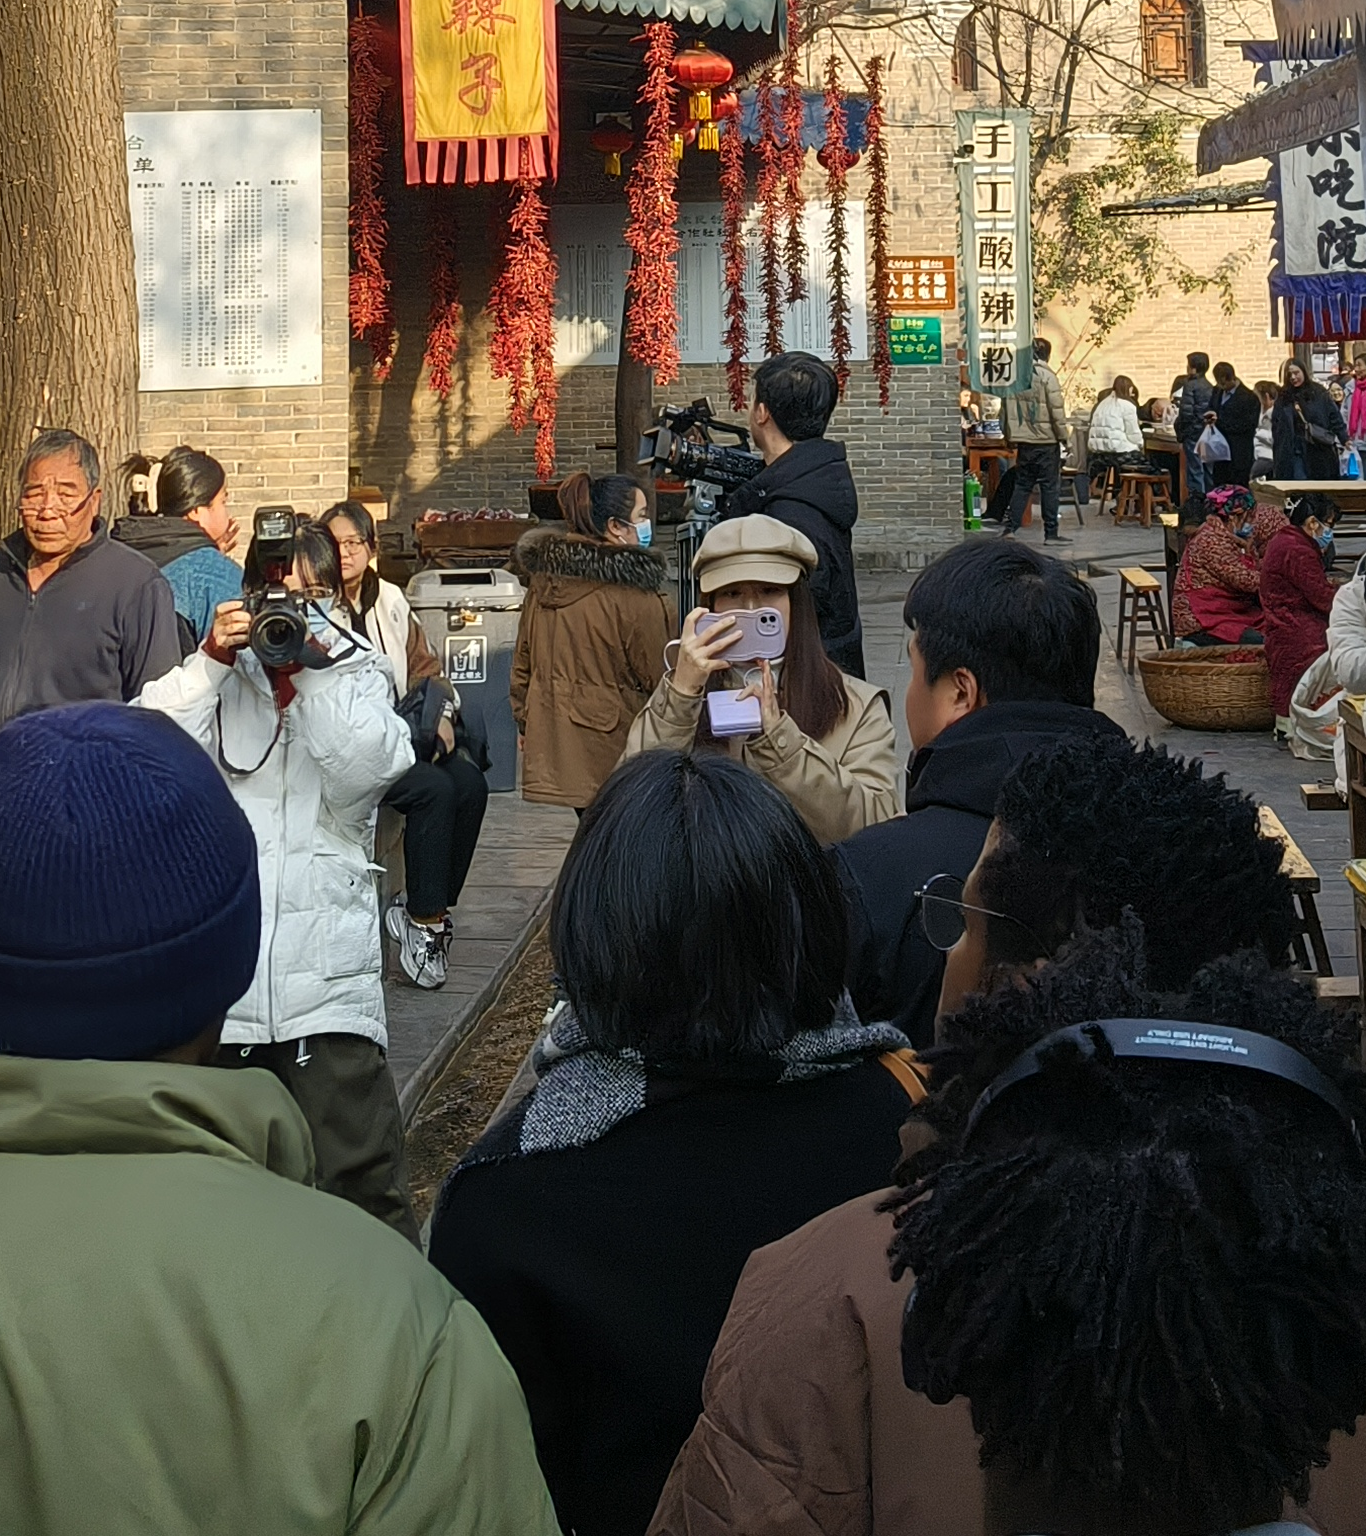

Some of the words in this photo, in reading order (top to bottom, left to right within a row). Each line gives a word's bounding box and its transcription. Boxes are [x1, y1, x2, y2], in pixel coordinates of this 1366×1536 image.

[974, 123, 1016, 383] 手工酸辣粉
